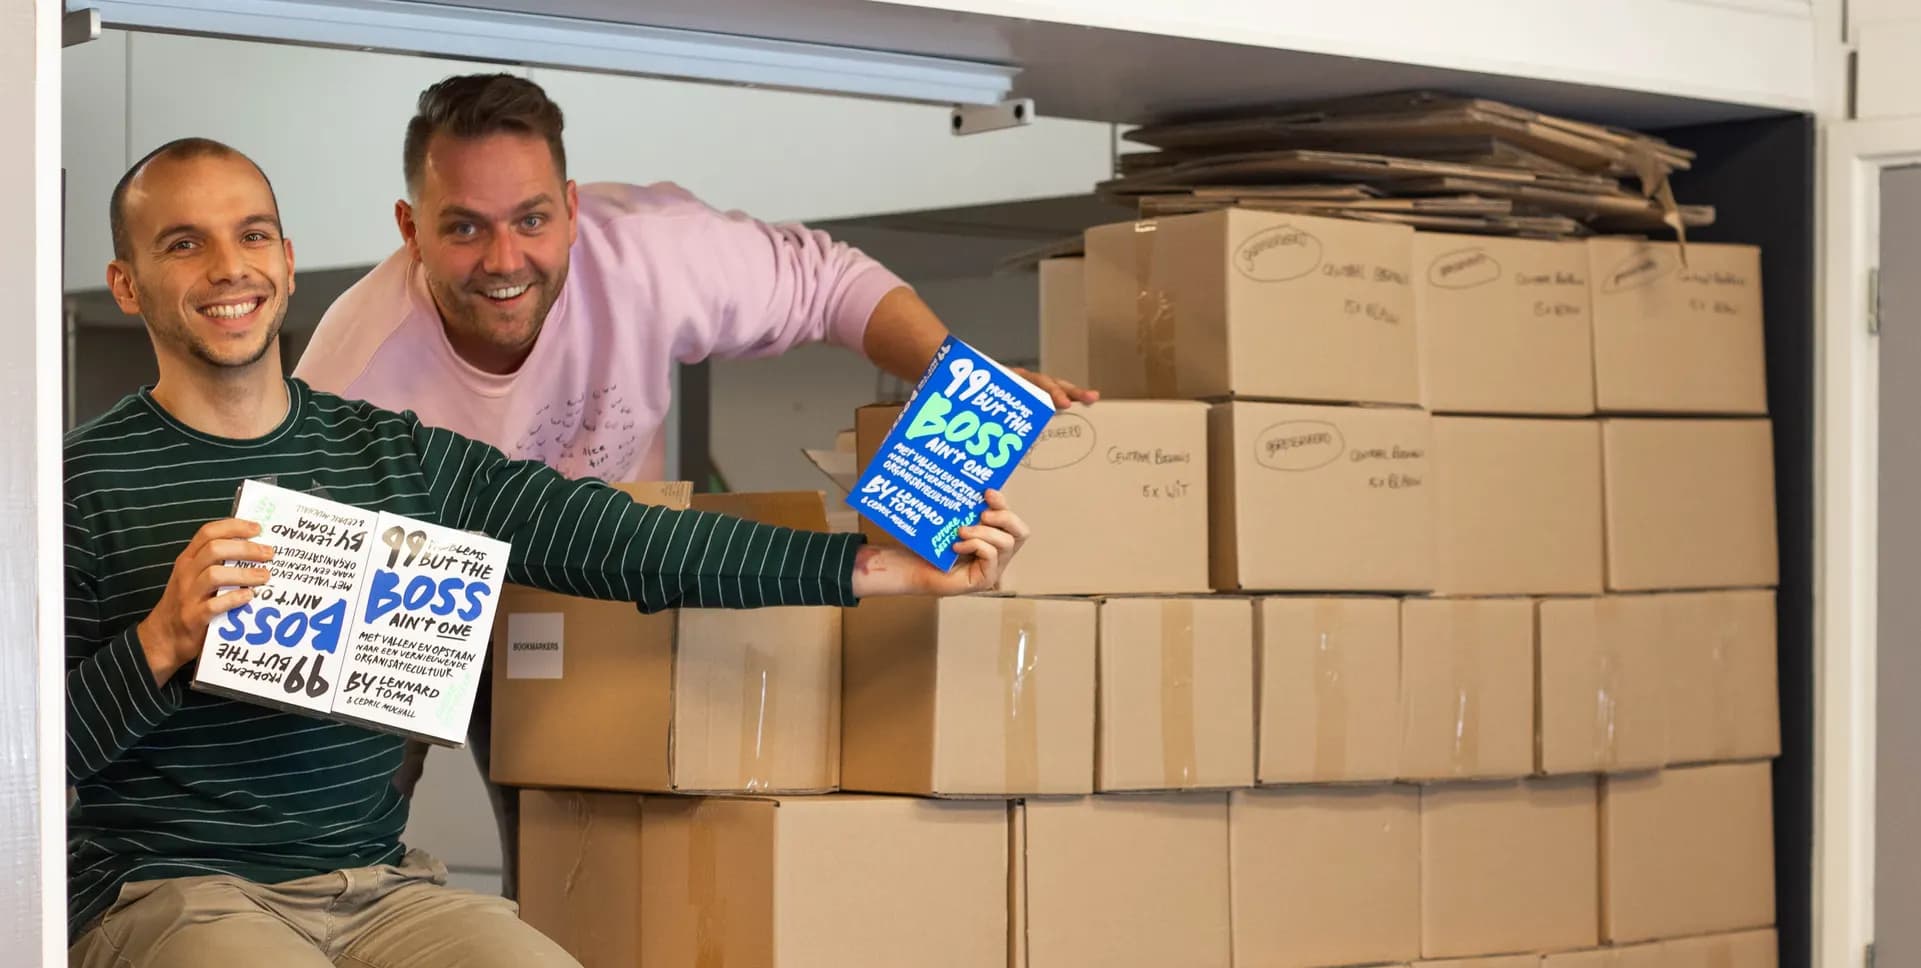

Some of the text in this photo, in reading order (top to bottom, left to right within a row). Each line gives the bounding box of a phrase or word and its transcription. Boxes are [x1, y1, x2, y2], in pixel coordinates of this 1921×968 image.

[944, 358, 991, 402] 99
[985, 382, 1033, 418] PROBLEMS
[971, 392, 1033, 437] BUT THE
[905, 391, 1023, 468] BOSS
[888, 452, 910, 467] NAAR
[909, 464, 925, 476] EEN
[893, 442, 915, 457] MET
[913, 452, 945, 475] VALLEN
[940, 471, 954, 482] EN
[925, 437, 994, 481] AIN'T ONE
[861, 474, 944, 525] BY LENNARD
[888, 496, 922, 526] TOMA
[271, 524, 368, 552] BY LENNARD
[298, 517, 336, 536] TOMA
[931, 517, 961, 548] FUTURE
[382, 526, 427, 569] 99
[280, 571, 295, 580] EN
[313, 567, 331, 576] EEN
[332, 570, 355, 579] NAAR
[419, 552, 493, 580] BUT THE
[295, 574, 329, 588] VALLEN
[331, 582, 353, 591] MET
[275, 590, 322, 610] AIN'T
[365, 568, 491, 624] BOSS
[218, 599, 347, 654] BOSS
[389, 613, 472, 637] AIN'T ONE
[216, 643, 292, 671] BUT THE
[355, 644, 468, 671] NAAR EEN VERNIEUWENDE
[358, 631, 477, 662] MET VALLEN EN OPSTAAN
[513, 641, 559, 651] BOOKMARKERS
[222, 653, 329, 698] 99 PROBLEMS
[354, 653, 453, 678] ORGANISATIECULTUUR
[343, 671, 440, 699] BY LENNARD
[376, 686, 415, 706] TOMA
[353, 697, 382, 709] CEDRIC
[382, 703, 416, 718] MUCHALL
